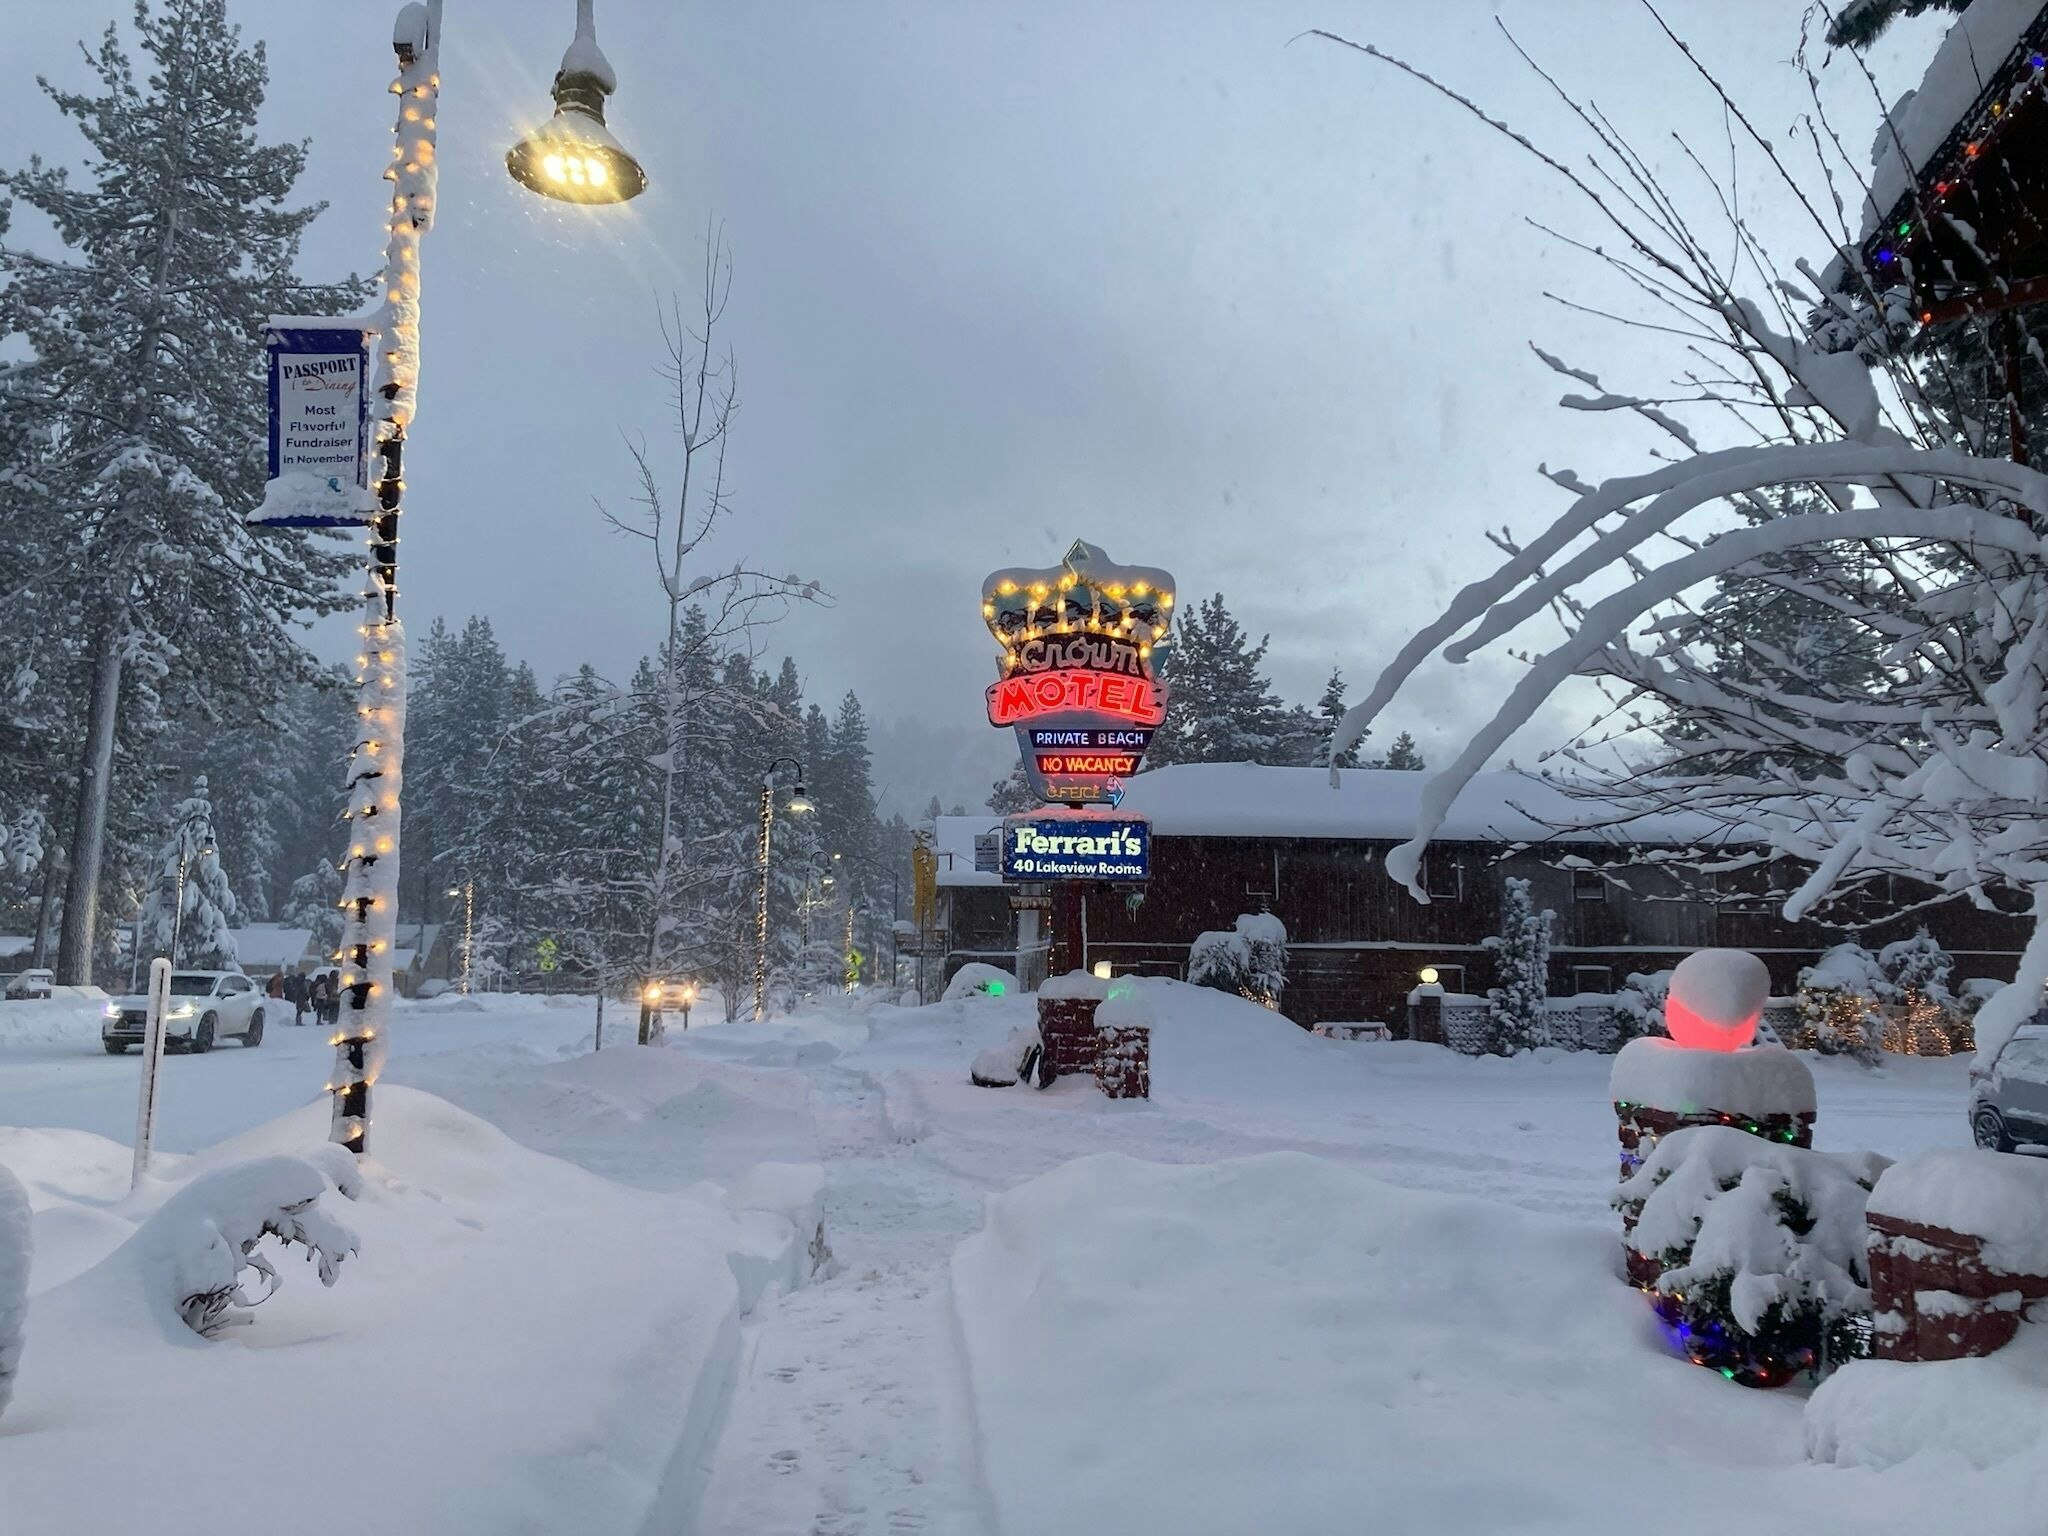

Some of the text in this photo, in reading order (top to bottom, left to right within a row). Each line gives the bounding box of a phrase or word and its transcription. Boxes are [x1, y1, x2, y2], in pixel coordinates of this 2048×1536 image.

[283, 357, 356, 379] PASSPORT
[293, 374, 356, 398] Dining
[305, 405, 336, 415] Most
[290, 421, 346, 431] Flavorful
[286, 438, 353, 448] Fundraiser
[297, 453, 355, 463] November
[1020, 637, 1139, 673] Crown
[999, 674, 1156, 720] MOTEL
[1036, 732, 1144, 745] PRIVATE BEACH
[1043, 757, 1135, 772] NO VACANCY
[1014, 827, 1142, 856] Ferrari's
[1013, 859, 1143, 875] 40 Lakeview Rooms
